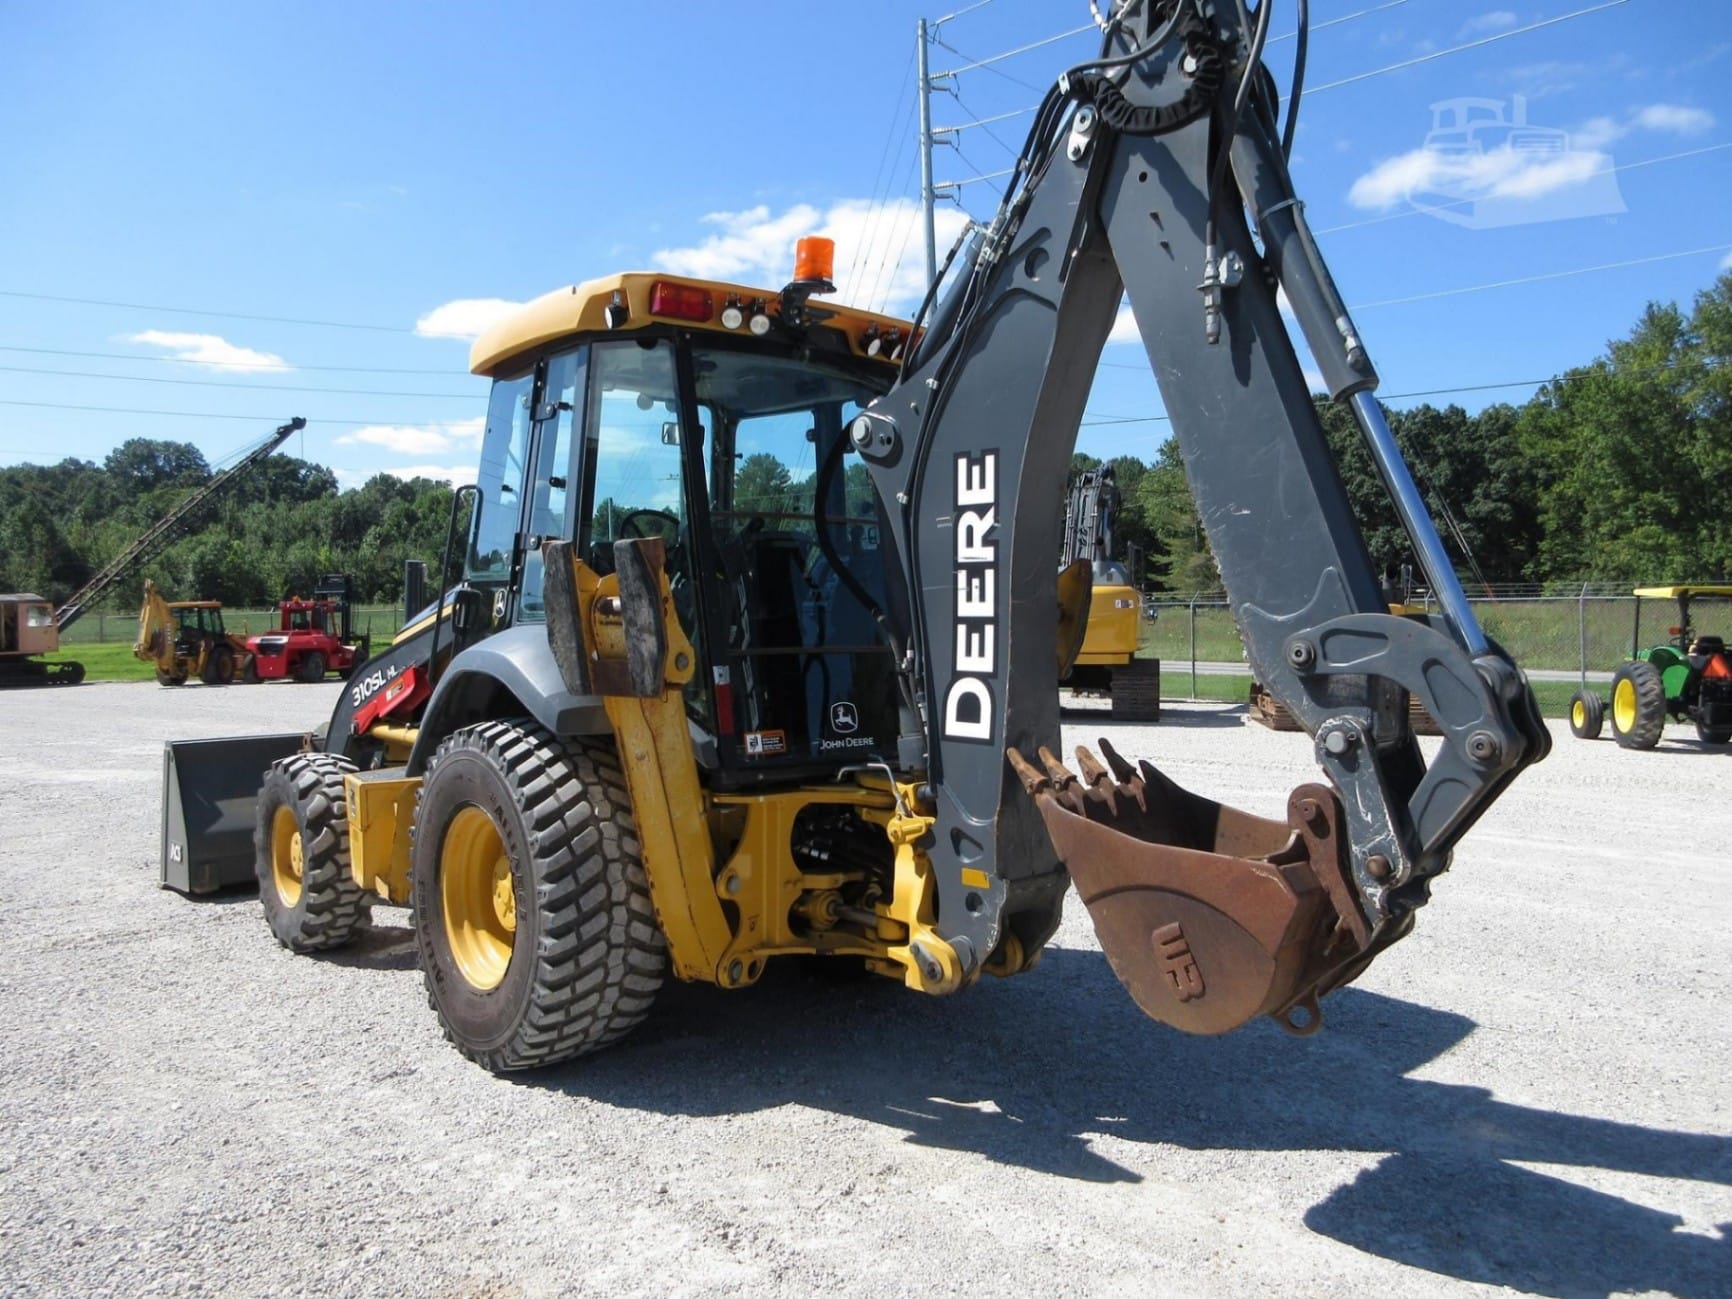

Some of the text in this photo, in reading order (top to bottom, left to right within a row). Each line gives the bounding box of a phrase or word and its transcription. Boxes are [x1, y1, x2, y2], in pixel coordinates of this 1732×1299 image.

[944, 454, 996, 740] DEERE
[352, 665, 398, 706] 310SL HL
[820, 737, 874, 750] JOHN DEERE
